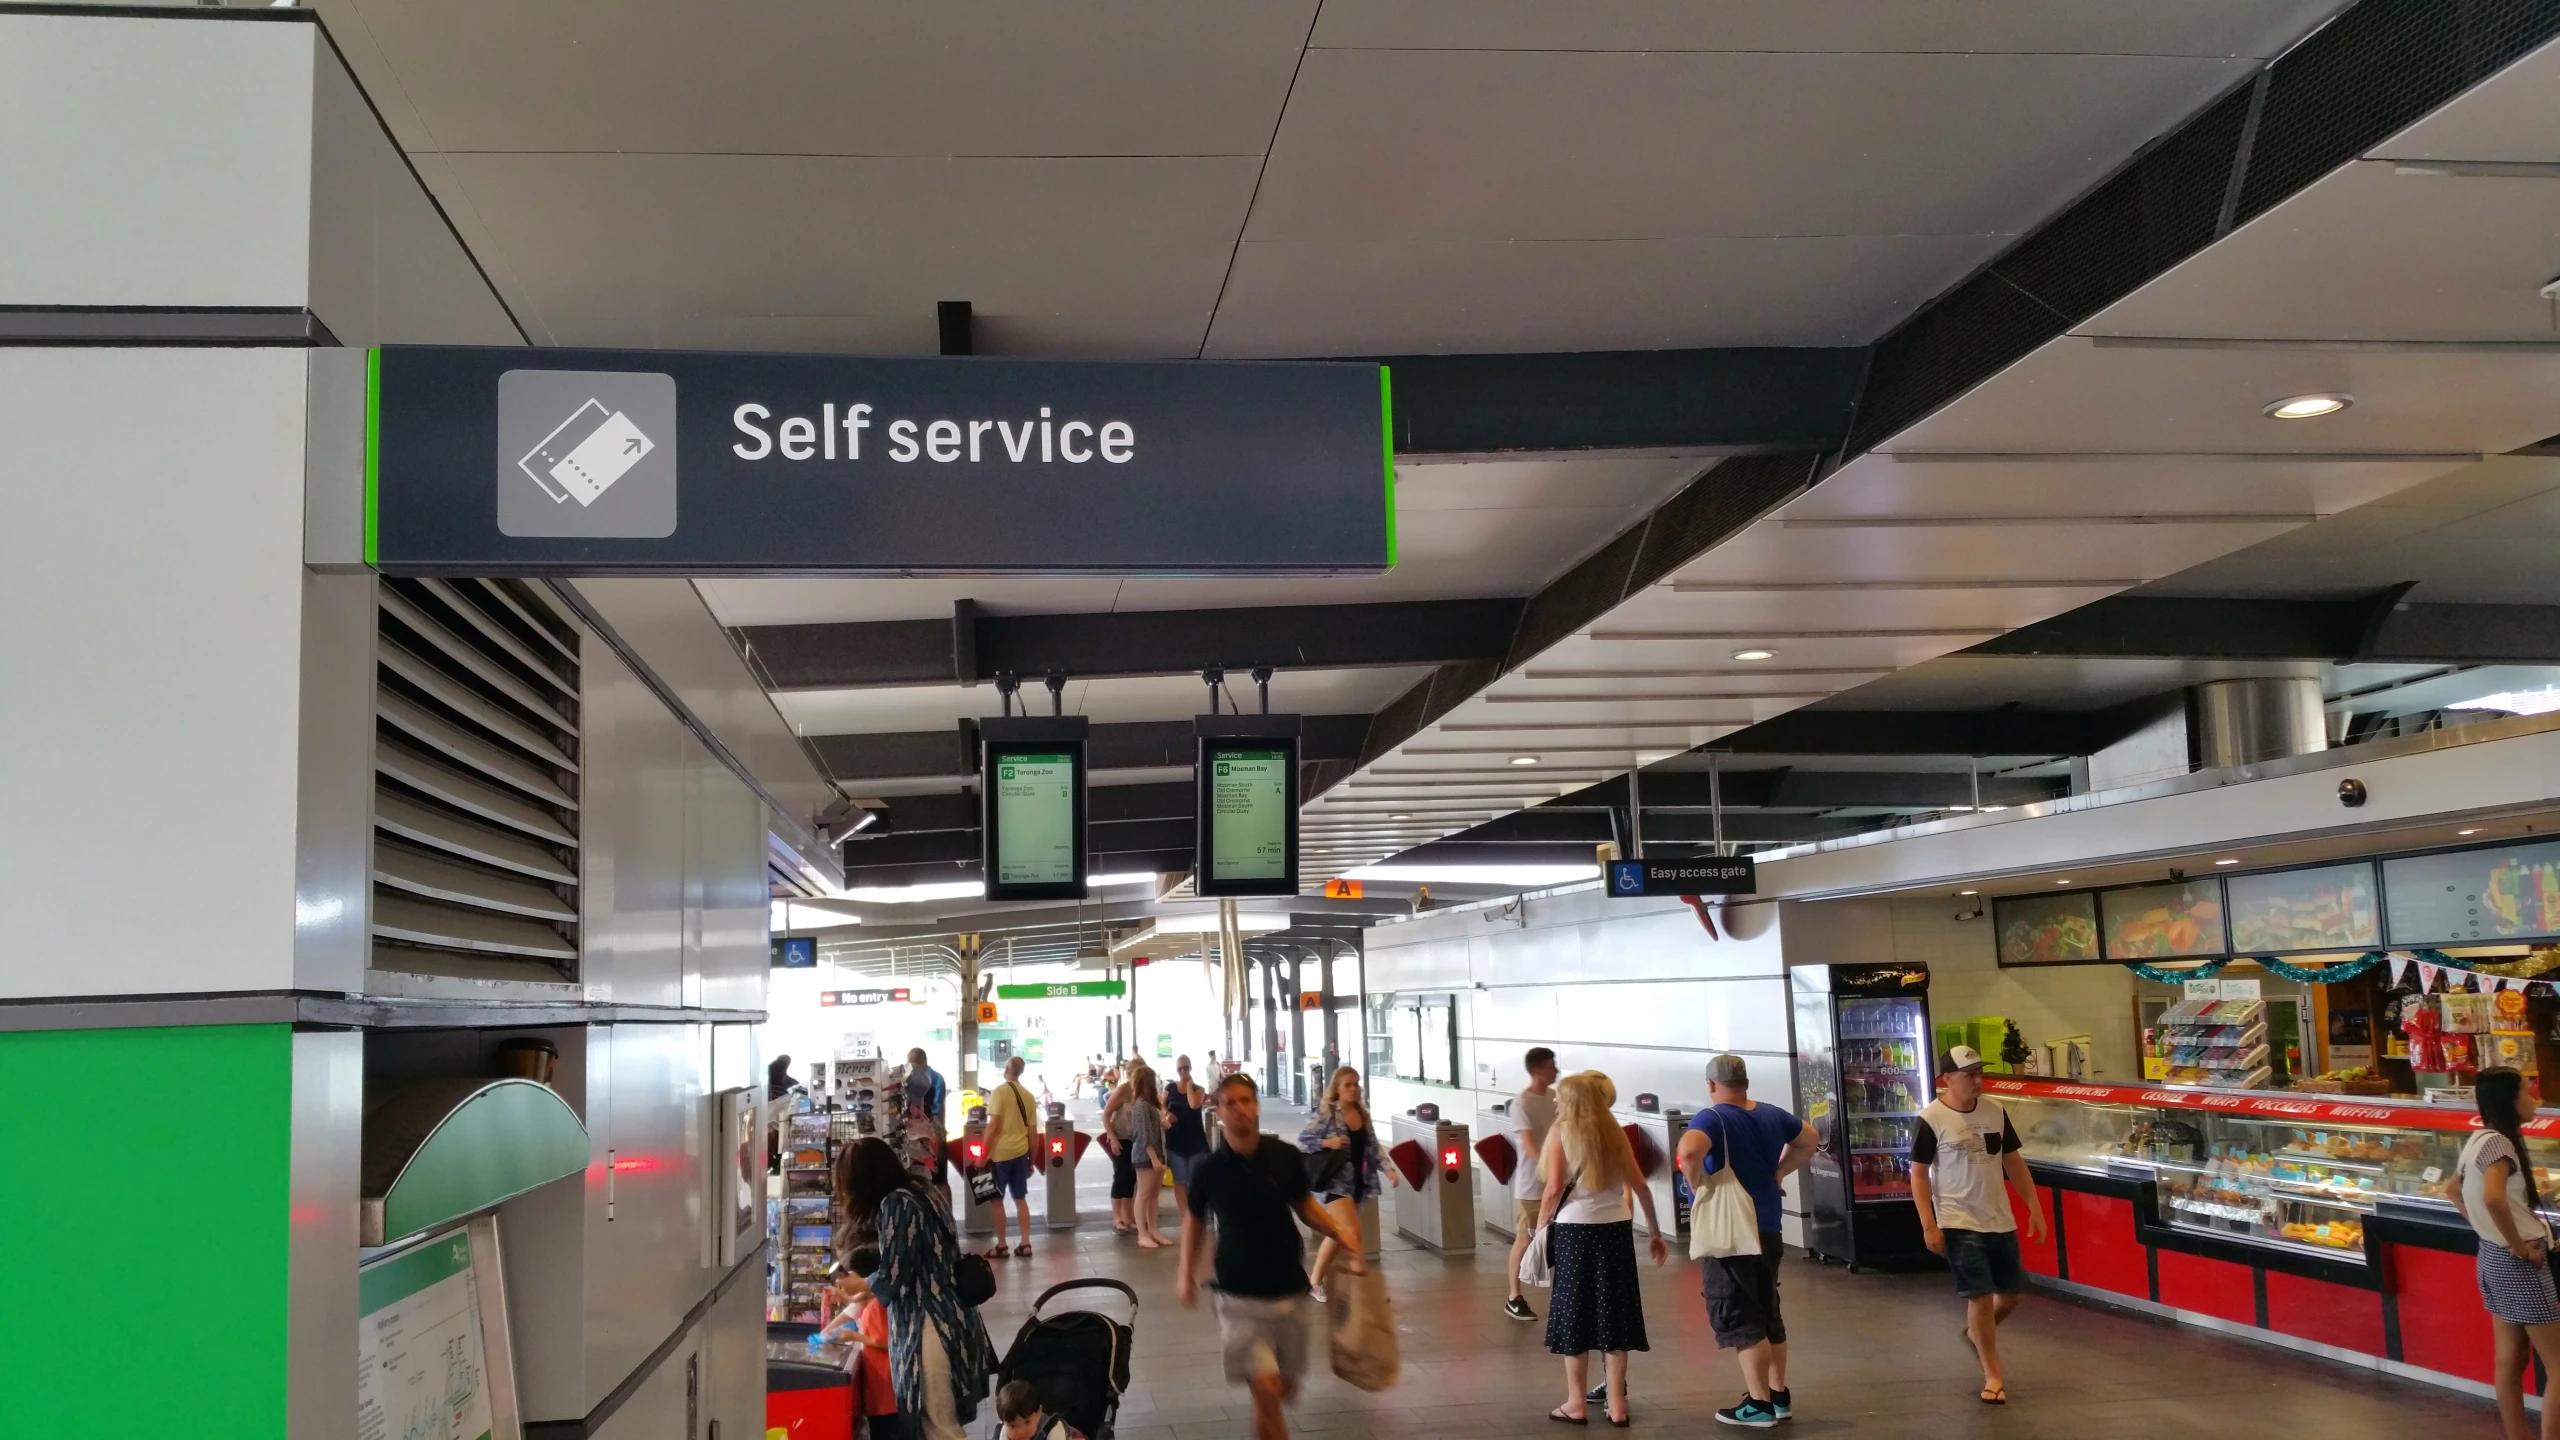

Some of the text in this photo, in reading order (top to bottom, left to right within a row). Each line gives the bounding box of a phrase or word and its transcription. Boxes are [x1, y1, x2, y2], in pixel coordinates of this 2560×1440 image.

[732, 402, 1134, 464] Self service
[1650, 866, 1746, 880] Easy access gate
[1336, 881, 1351, 896] A
[1046, 985, 1078, 996] Side B
[842, 992, 888, 1004] No entry
[1306, 996, 1316, 1008] A
[982, 1007, 993, 1019] B
[1992, 1082, 2027, 1090] SALADS
[2052, 1086, 2113, 1097] SANDWICHES
[2141, 1092, 2187, 1102] CASHIER
[2201, 1096, 2244, 1107] WRAPS
[2250, 1100, 2322, 1114] FOCCACIAS
[2329, 1106, 2396, 1119] MUFFINS
